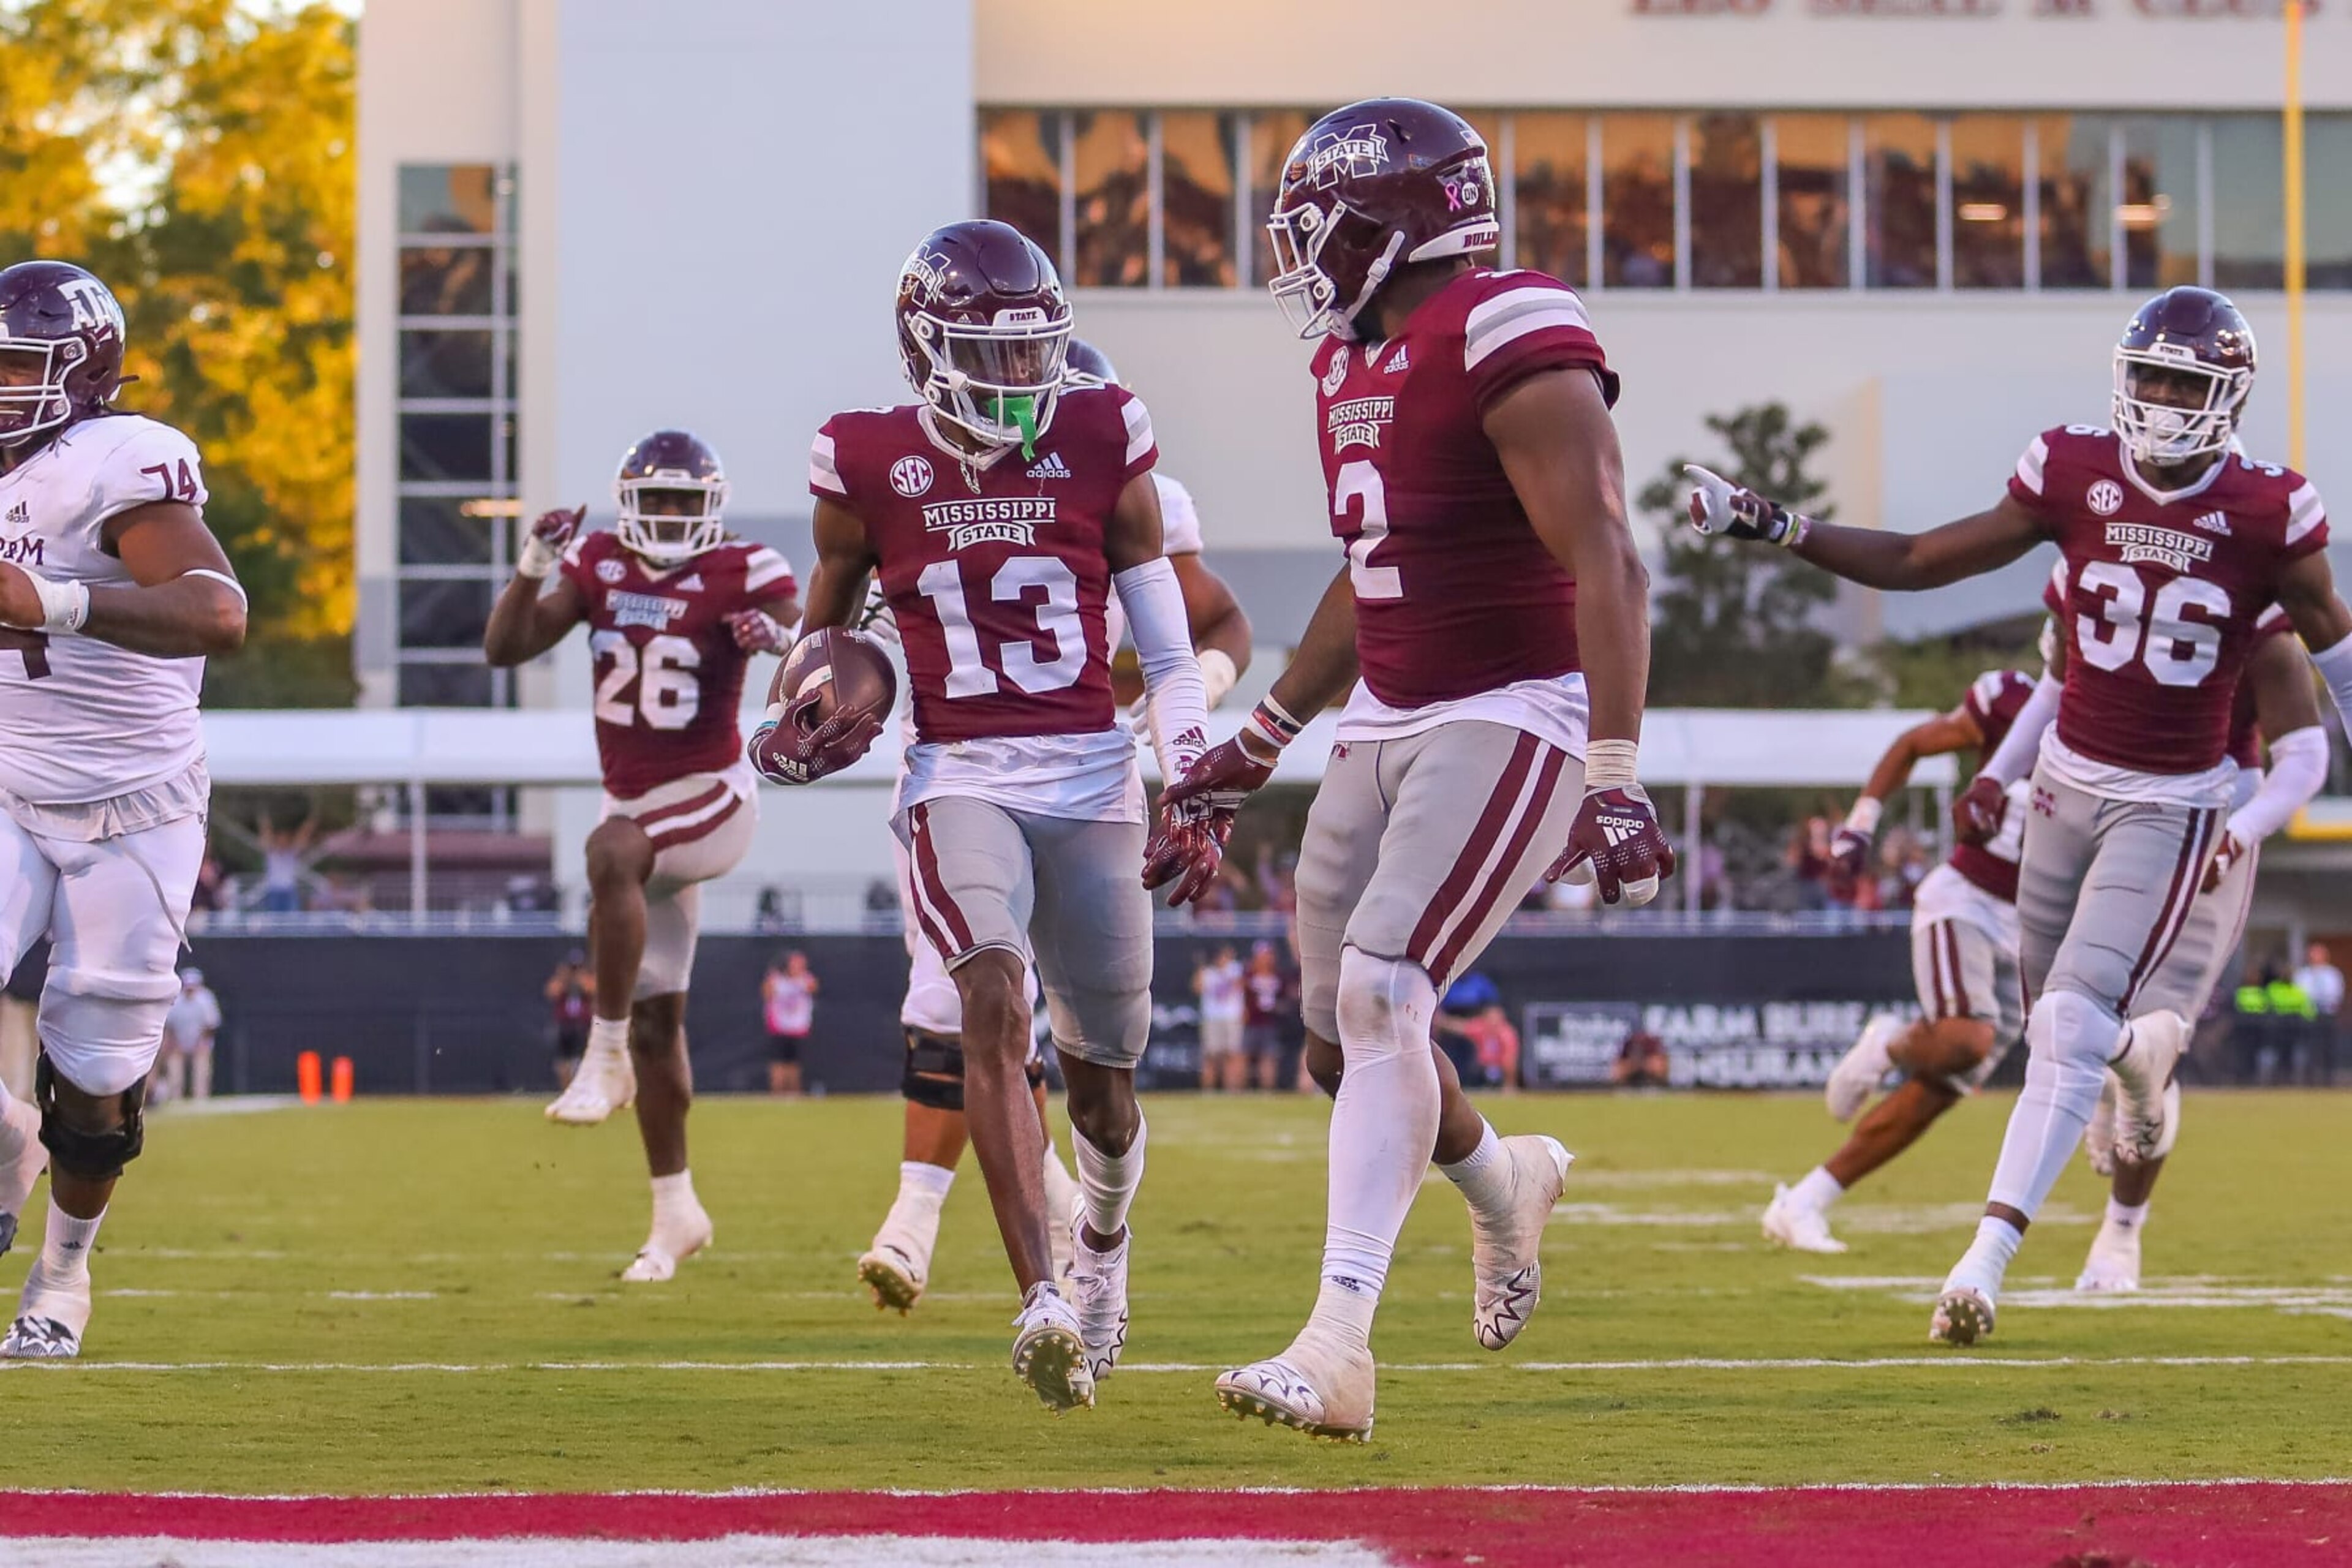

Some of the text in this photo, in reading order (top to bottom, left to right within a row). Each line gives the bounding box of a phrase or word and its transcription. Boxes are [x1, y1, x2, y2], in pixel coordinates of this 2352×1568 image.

[1318, 141, 1369, 167] STATE
[1464, 187, 1477, 202] DN
[1009, 311, 1038, 322] STATE
[1328, 401, 1394, 429] MISSISSIPPI
[1340, 426, 1371, 446] STATE
[141, 458, 197, 500] 74
[893, 459, 930, 494] SEC
[1027, 467, 1071, 479] adidas
[2089, 482, 2122, 511] SEC
[923, 502, 1056, 529] MISSISSIPPI
[1335, 460, 1404, 598] 2
[963, 524, 1020, 543] STATE
[2105, 526, 2212, 558] MISSISSIPPI
[918, 556, 1087, 699] 13
[2077, 561, 2231, 687] 36
[589, 629, 701, 729] 26
[1596, 815, 1645, 829] adidas
